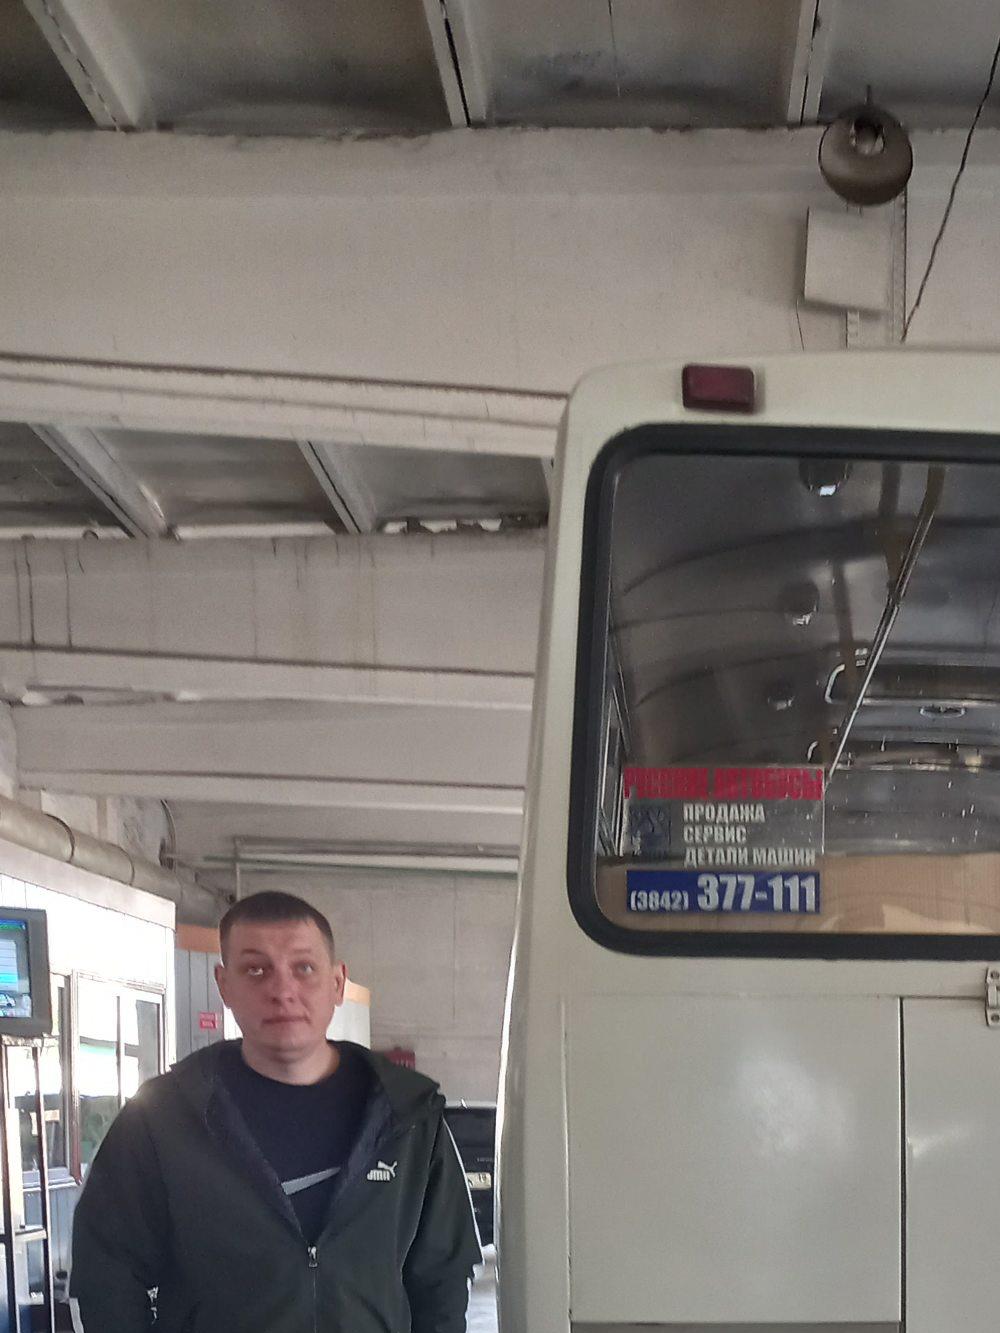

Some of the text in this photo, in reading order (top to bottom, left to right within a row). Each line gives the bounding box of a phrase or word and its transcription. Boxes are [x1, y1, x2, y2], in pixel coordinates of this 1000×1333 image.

[683, 803, 766, 824] ПРОДАЖА
[683, 825, 747, 844] СЕРВИС
[684, 848, 816, 869] ДЕТАЛИ МАШИН
[630, 873, 816, 913] (3842) 377-111
